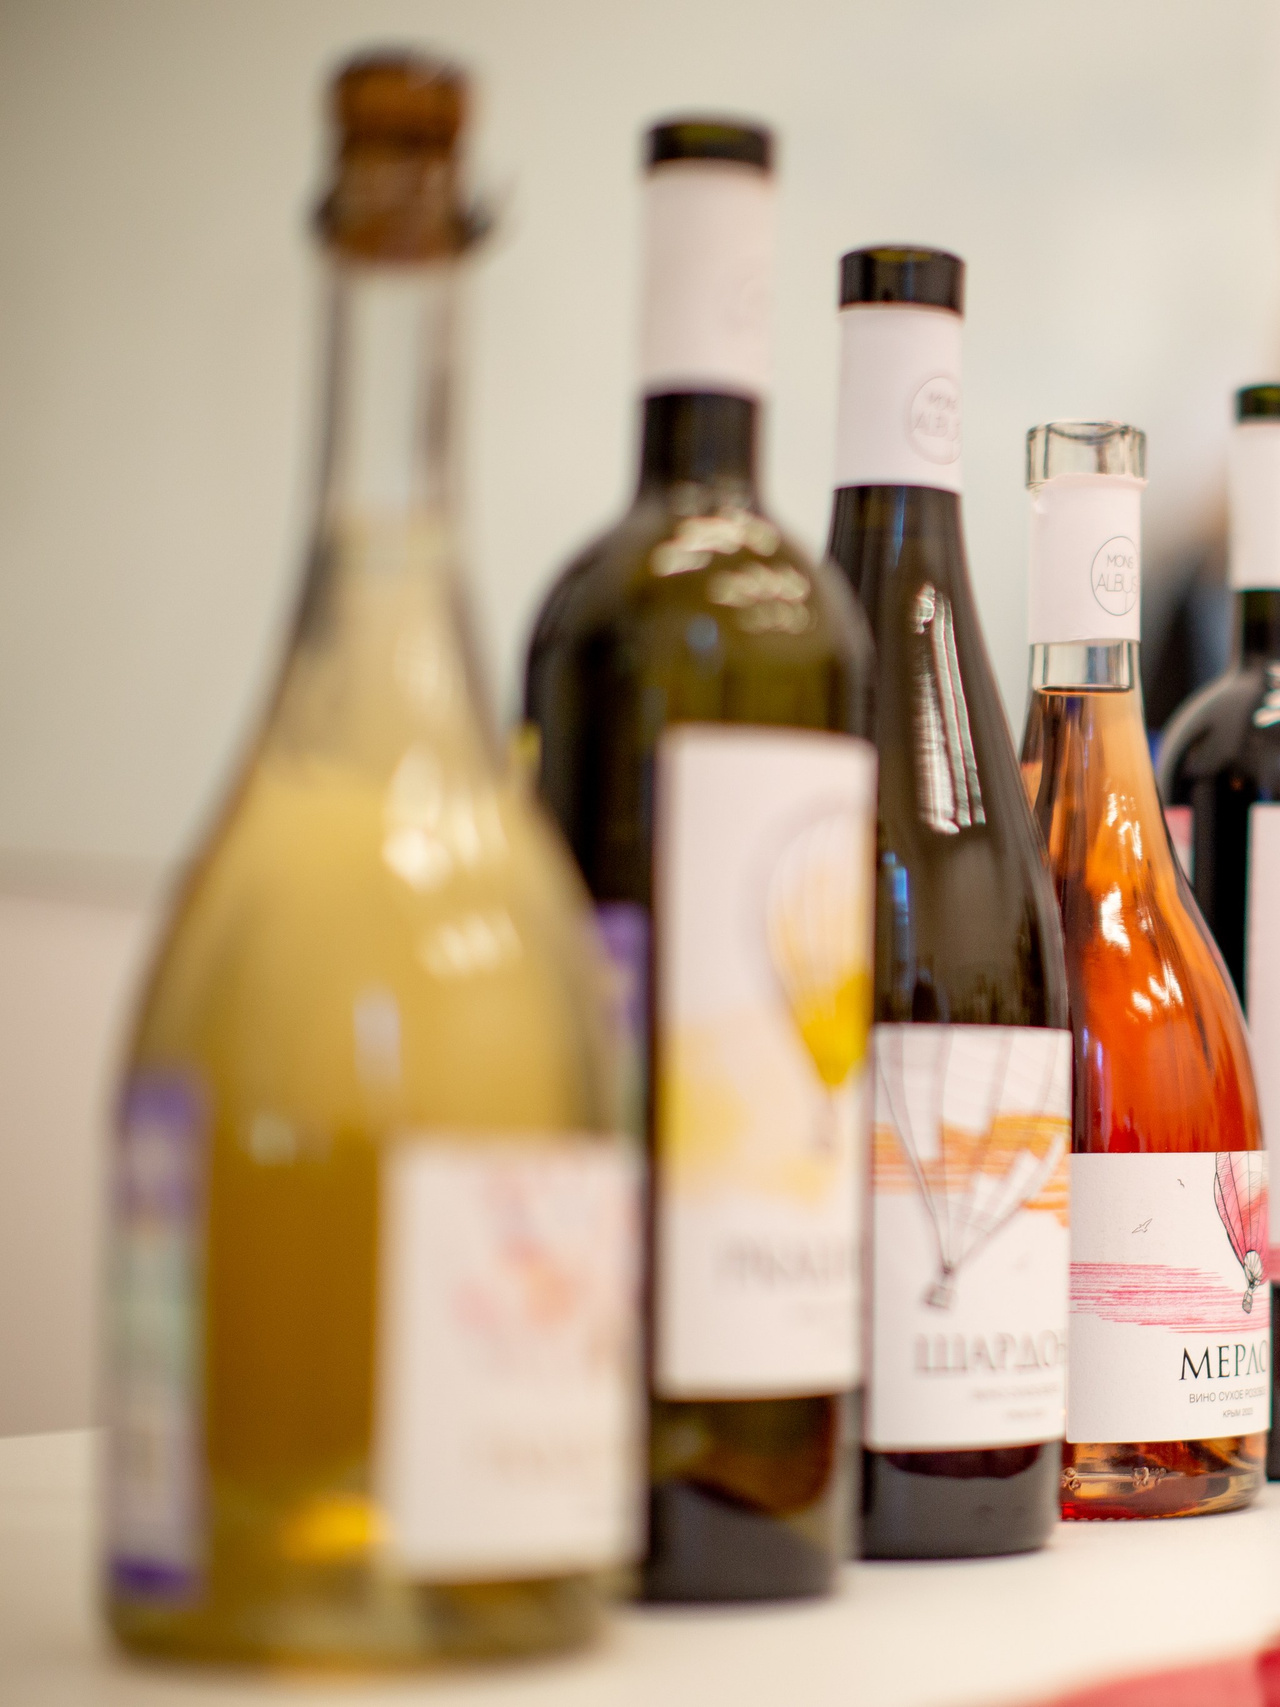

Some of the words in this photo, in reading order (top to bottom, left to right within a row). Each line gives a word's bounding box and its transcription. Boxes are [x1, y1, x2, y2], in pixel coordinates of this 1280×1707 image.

[1107, 554, 1134, 569] MONS
[1095, 573, 1137, 593] ALBUS
[1189, 1392, 1216, 1403] ВИНО
[1218, 1389, 1244, 1402] СУХОЕ
[1222, 1409, 1241, 1418] КРЫМ
